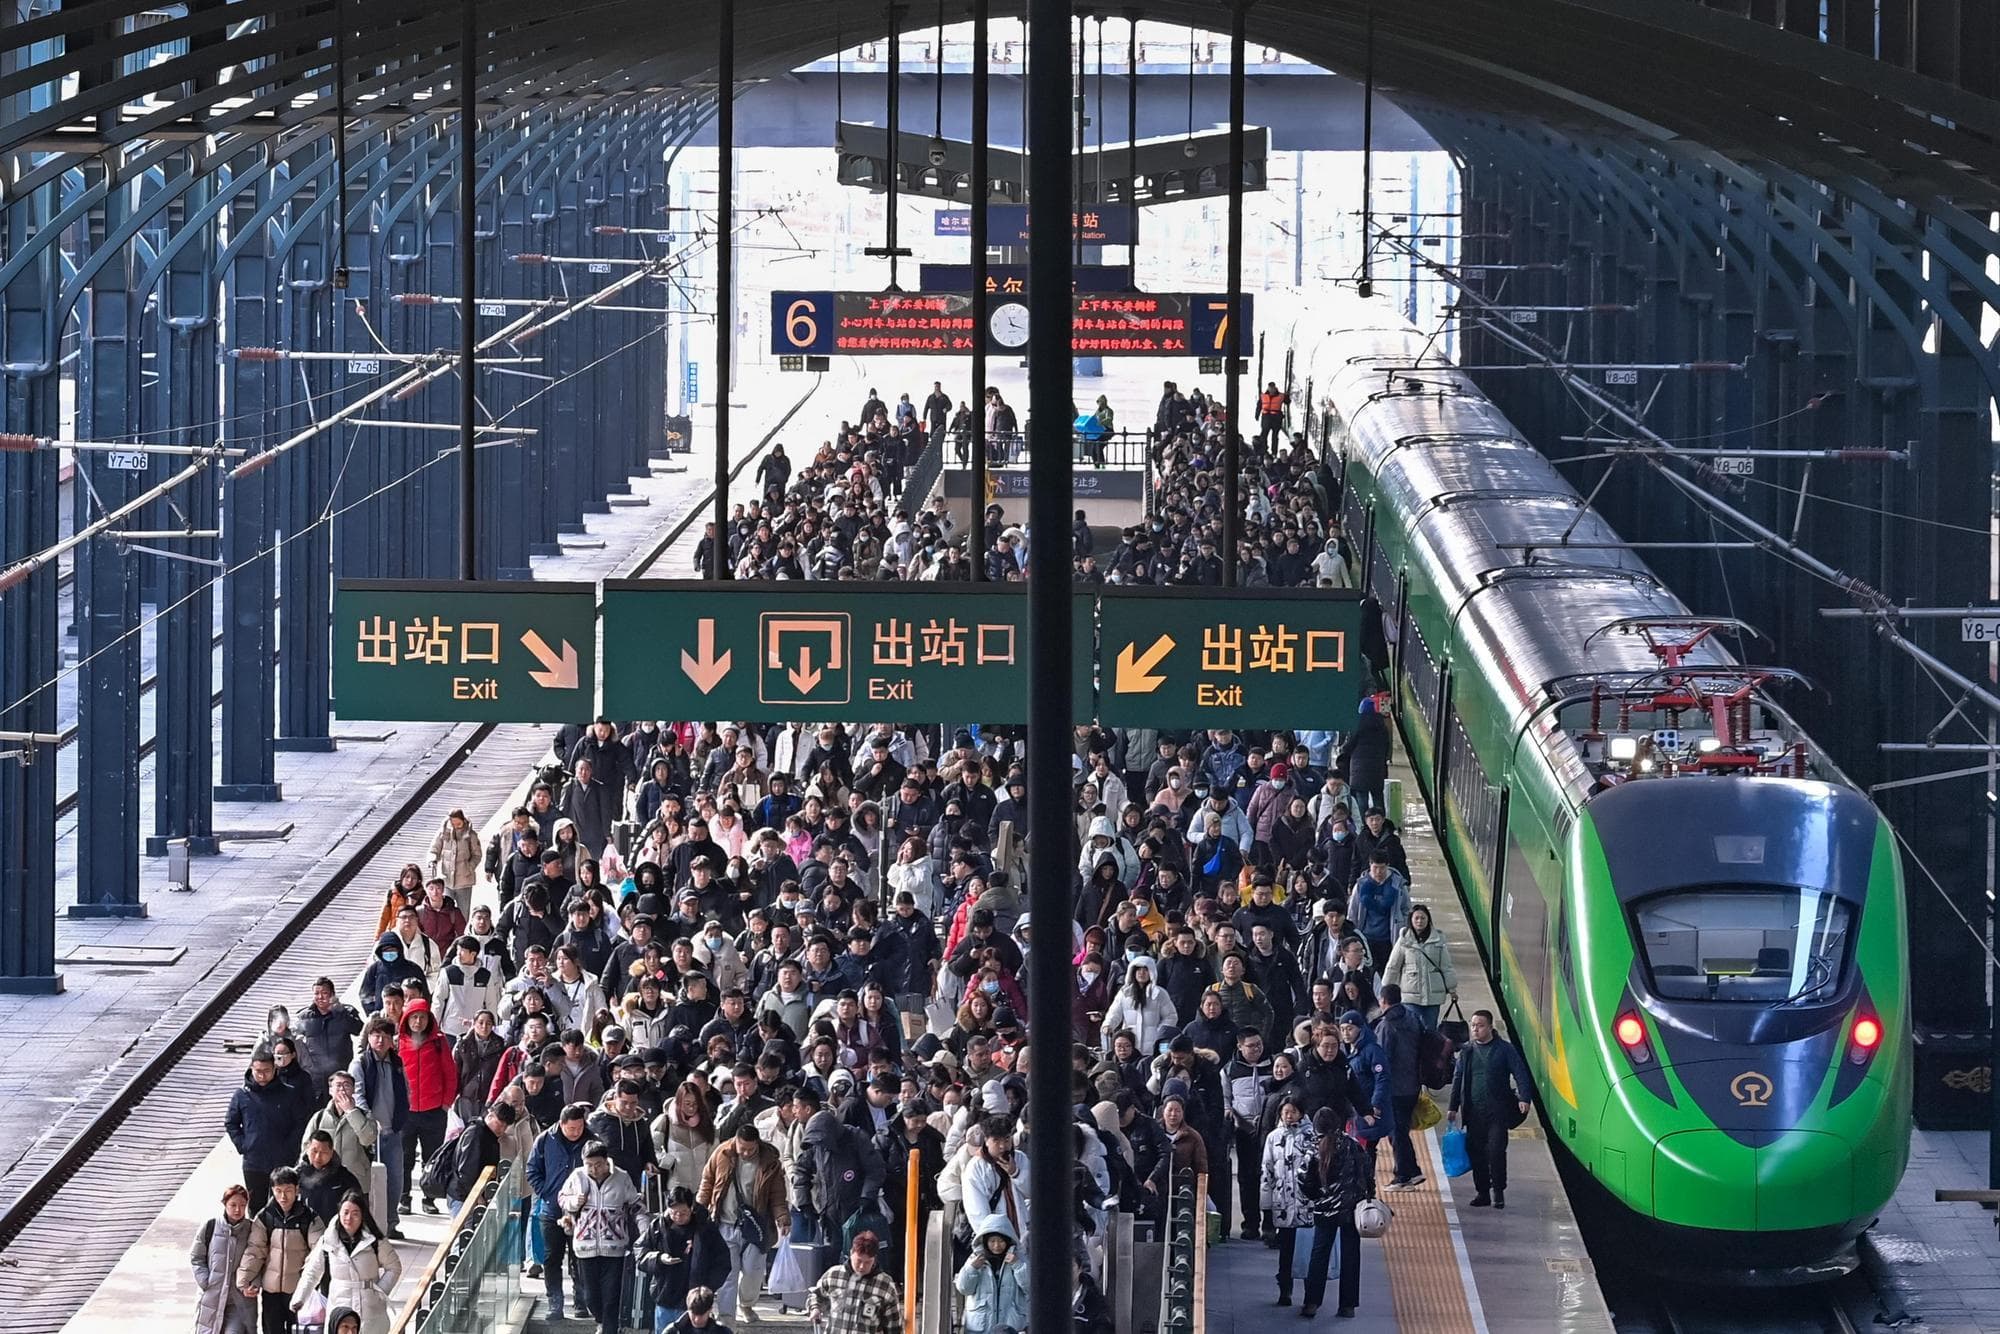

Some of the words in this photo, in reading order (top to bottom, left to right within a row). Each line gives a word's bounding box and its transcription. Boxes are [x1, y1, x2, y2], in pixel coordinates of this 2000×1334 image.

[1078, 299, 1158, 312] 上下车不要拥挤
[786, 299, 817, 347] 6
[1208, 302, 1228, 350] 7
[350, 362, 378, 373] Y7-05
[1606, 372, 1636, 383] Y8-05
[110, 455, 147, 469] Y7-06
[1715, 460, 1753, 473] Y8-06
[357, 616, 499, 665] 出站口
[873, 618, 1015, 667] 出站口
[1202, 624, 1345, 673] 出站口
[453, 677, 498, 699] Exit
[868, 678, 914, 700] Exit
[1197, 684, 1242, 706] Exit
